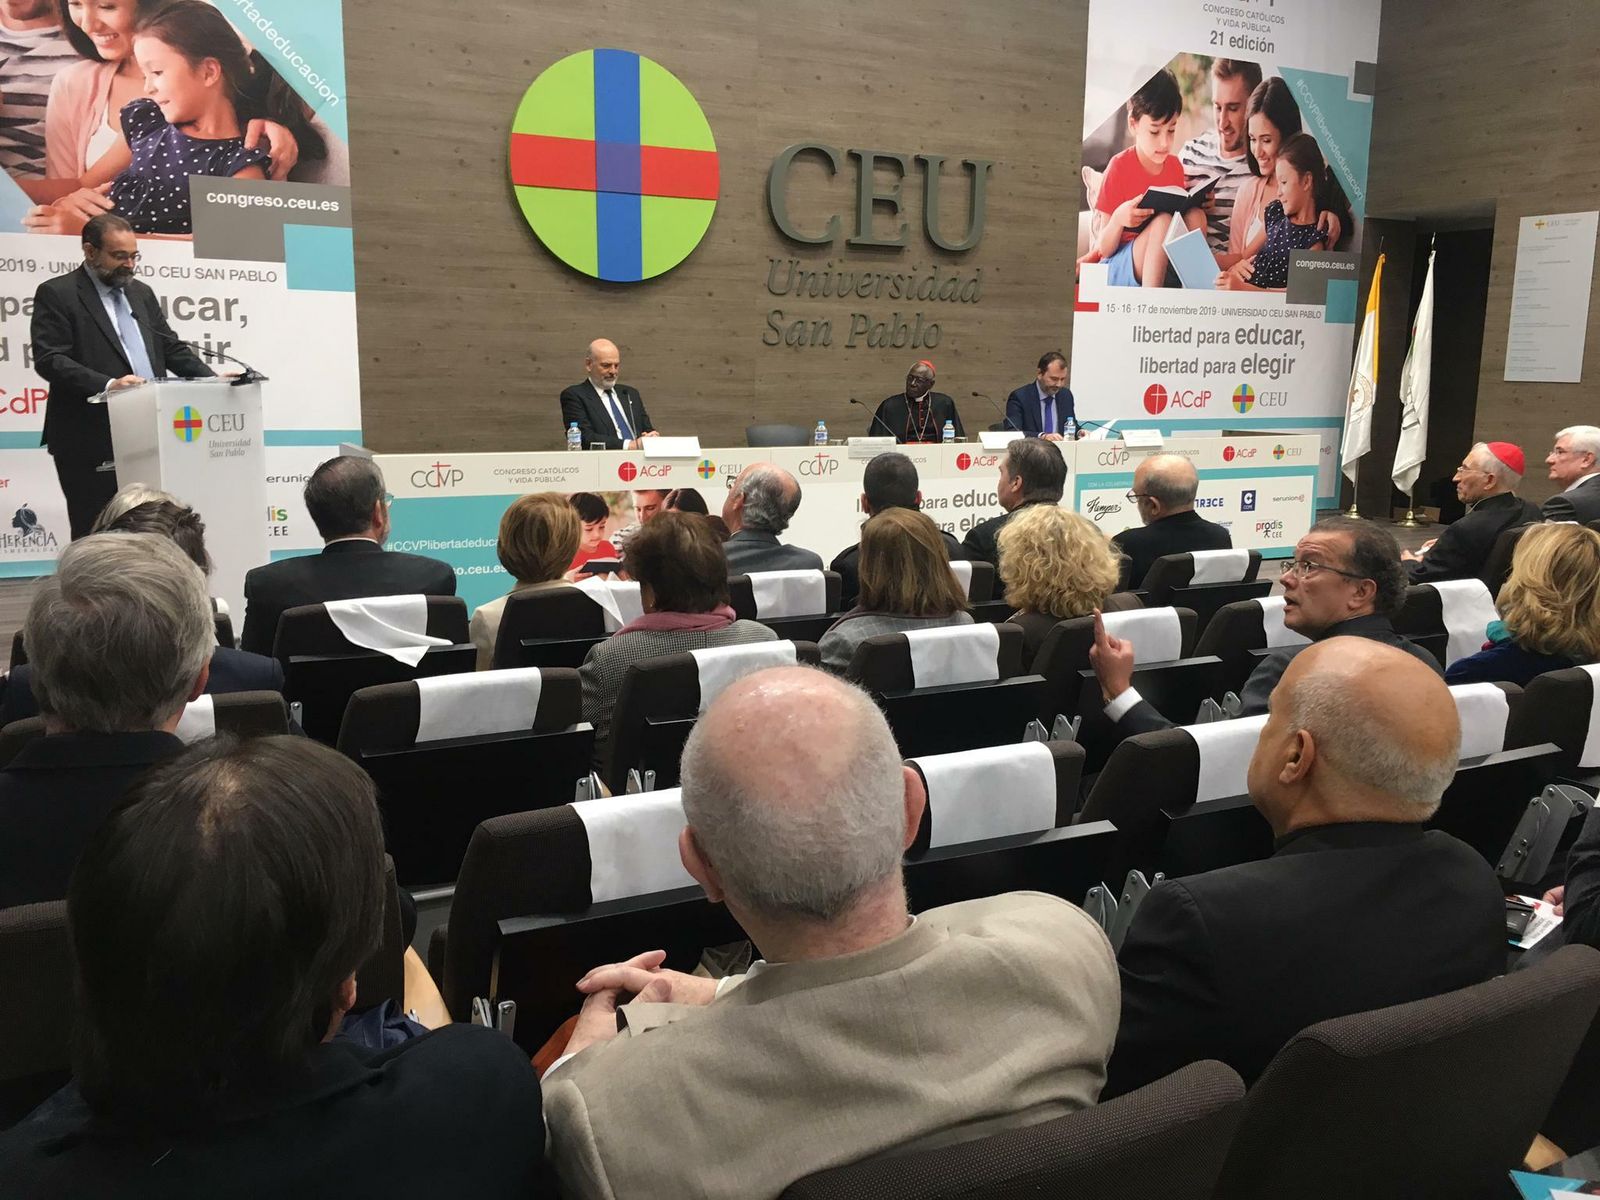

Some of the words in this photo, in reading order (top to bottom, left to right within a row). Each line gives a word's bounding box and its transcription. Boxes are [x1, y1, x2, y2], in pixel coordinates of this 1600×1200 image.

[1202, 3, 1245, 18] CONGRESO
[1216, 17, 1222, 25] Y
[1223, 19, 1240, 29] VIDA
[1209, 30, 1225, 46] 21
[1229, 35, 1276, 54] edición
[231, 0, 340, 107] rtadeducacion
[206, 192, 340, 212] congreso.ceu.es
[764, 143, 994, 252] CEU
[1296, 259, 1356, 271] congreso.ceu.es
[159, 266, 191, 279] CEU
[194, 267, 225, 281] SAN
[229, 269, 278, 283] PABLO
[766, 258, 984, 303] Universidad
[1106, 303, 1116, 313] 15
[1122, 304, 1132, 313] 16
[1137, 304, 1147, 314] 17
[1148, 305, 1158, 314] de
[1160, 305, 1198, 316] noviembre
[1199, 305, 1217, 316] 2019
[1221, 308, 1268, 318] UNIVERSIDAD
[1269, 309, 1284, 318] CEU
[1285, 310, 1299, 318] SAN
[1300, 310, 1322, 319] PABLO
[762, 310, 833, 347] San
[845, 312, 945, 348] Pablo
[1132, 325, 1193, 344] libertad
[1196, 330, 1230, 348] para
[1235, 323, 1305, 350] educar,
[1139, 356, 1199, 374] libertad
[1203, 361, 1236, 379] para
[1241, 353, 1296, 380] elegir
[1171, 390, 1212, 408] ACdP
[1259, 391, 1288, 407] CEU
[207, 413, 246, 433] CEU
[208, 438, 251, 449] Universidad
[209, 449, 223, 459] San
[225, 448, 246, 458] Pablo
[1236, 448, 1257, 458] ACdP
[1286, 448, 1302, 456] CEU
[719, 464, 742, 475] CEU
[973, 456, 999, 467] ACdP
[493, 468, 537, 476] CONGRESO
[538, 466, 580, 475] CATÓLICOS
[640, 465, 672, 478] ACdP
[953, 489, 998, 508] educ
[1256, 520, 1284, 533] prodis
[1271, 531, 1283, 539] CEE
